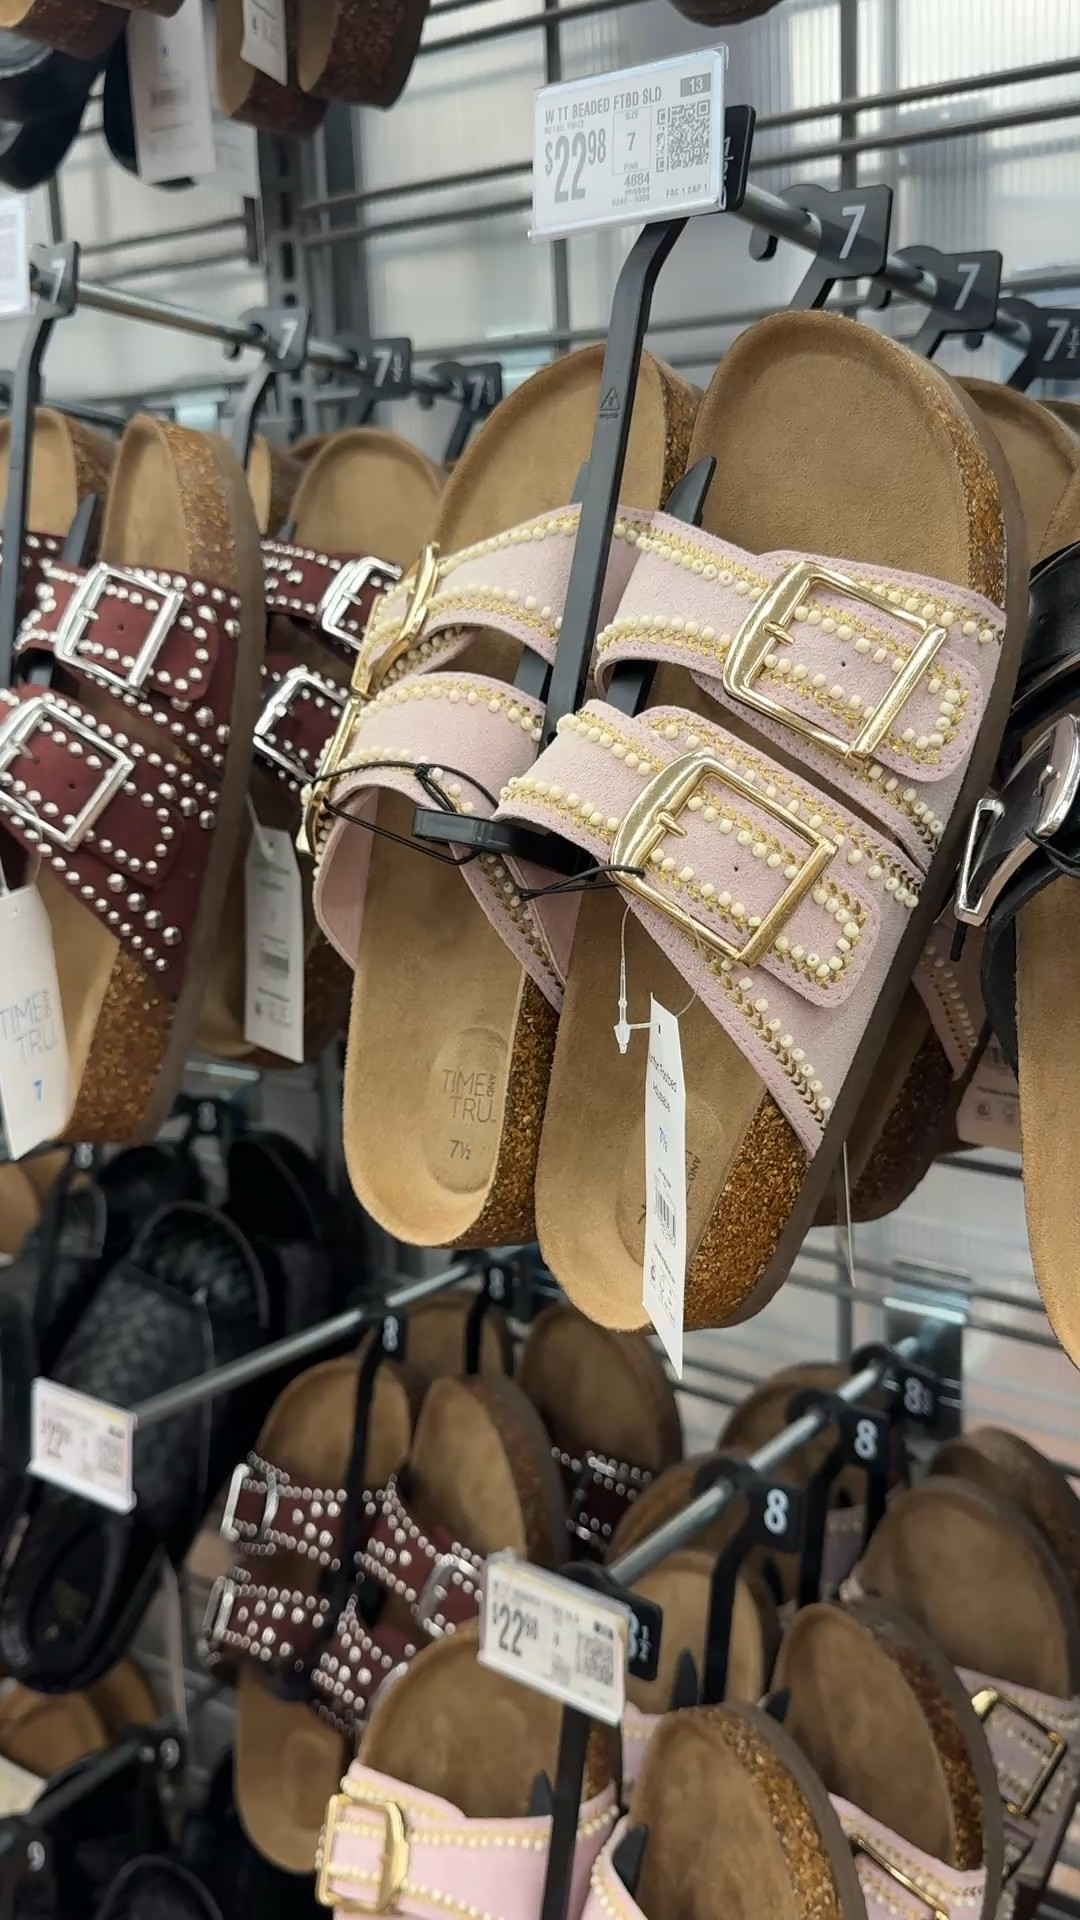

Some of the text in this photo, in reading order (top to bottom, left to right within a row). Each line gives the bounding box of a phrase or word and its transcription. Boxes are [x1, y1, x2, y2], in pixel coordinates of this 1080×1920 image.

[689, 77, 704, 93] 13
[544, 86, 662, 125] W TT BEADED FTBD SLD
[627, 132, 636, 151] 7
[839, 204, 866, 260] 7
[50, 259, 66, 304] 7
[954, 263, 981, 311] 7
[278, 320, 298, 359] 7
[441, 1068, 496, 1097] TIME AND
[449, 1096, 493, 1124] TRU
[854, 1419, 877, 1460] 8
[764, 1488, 789, 1536] 8
